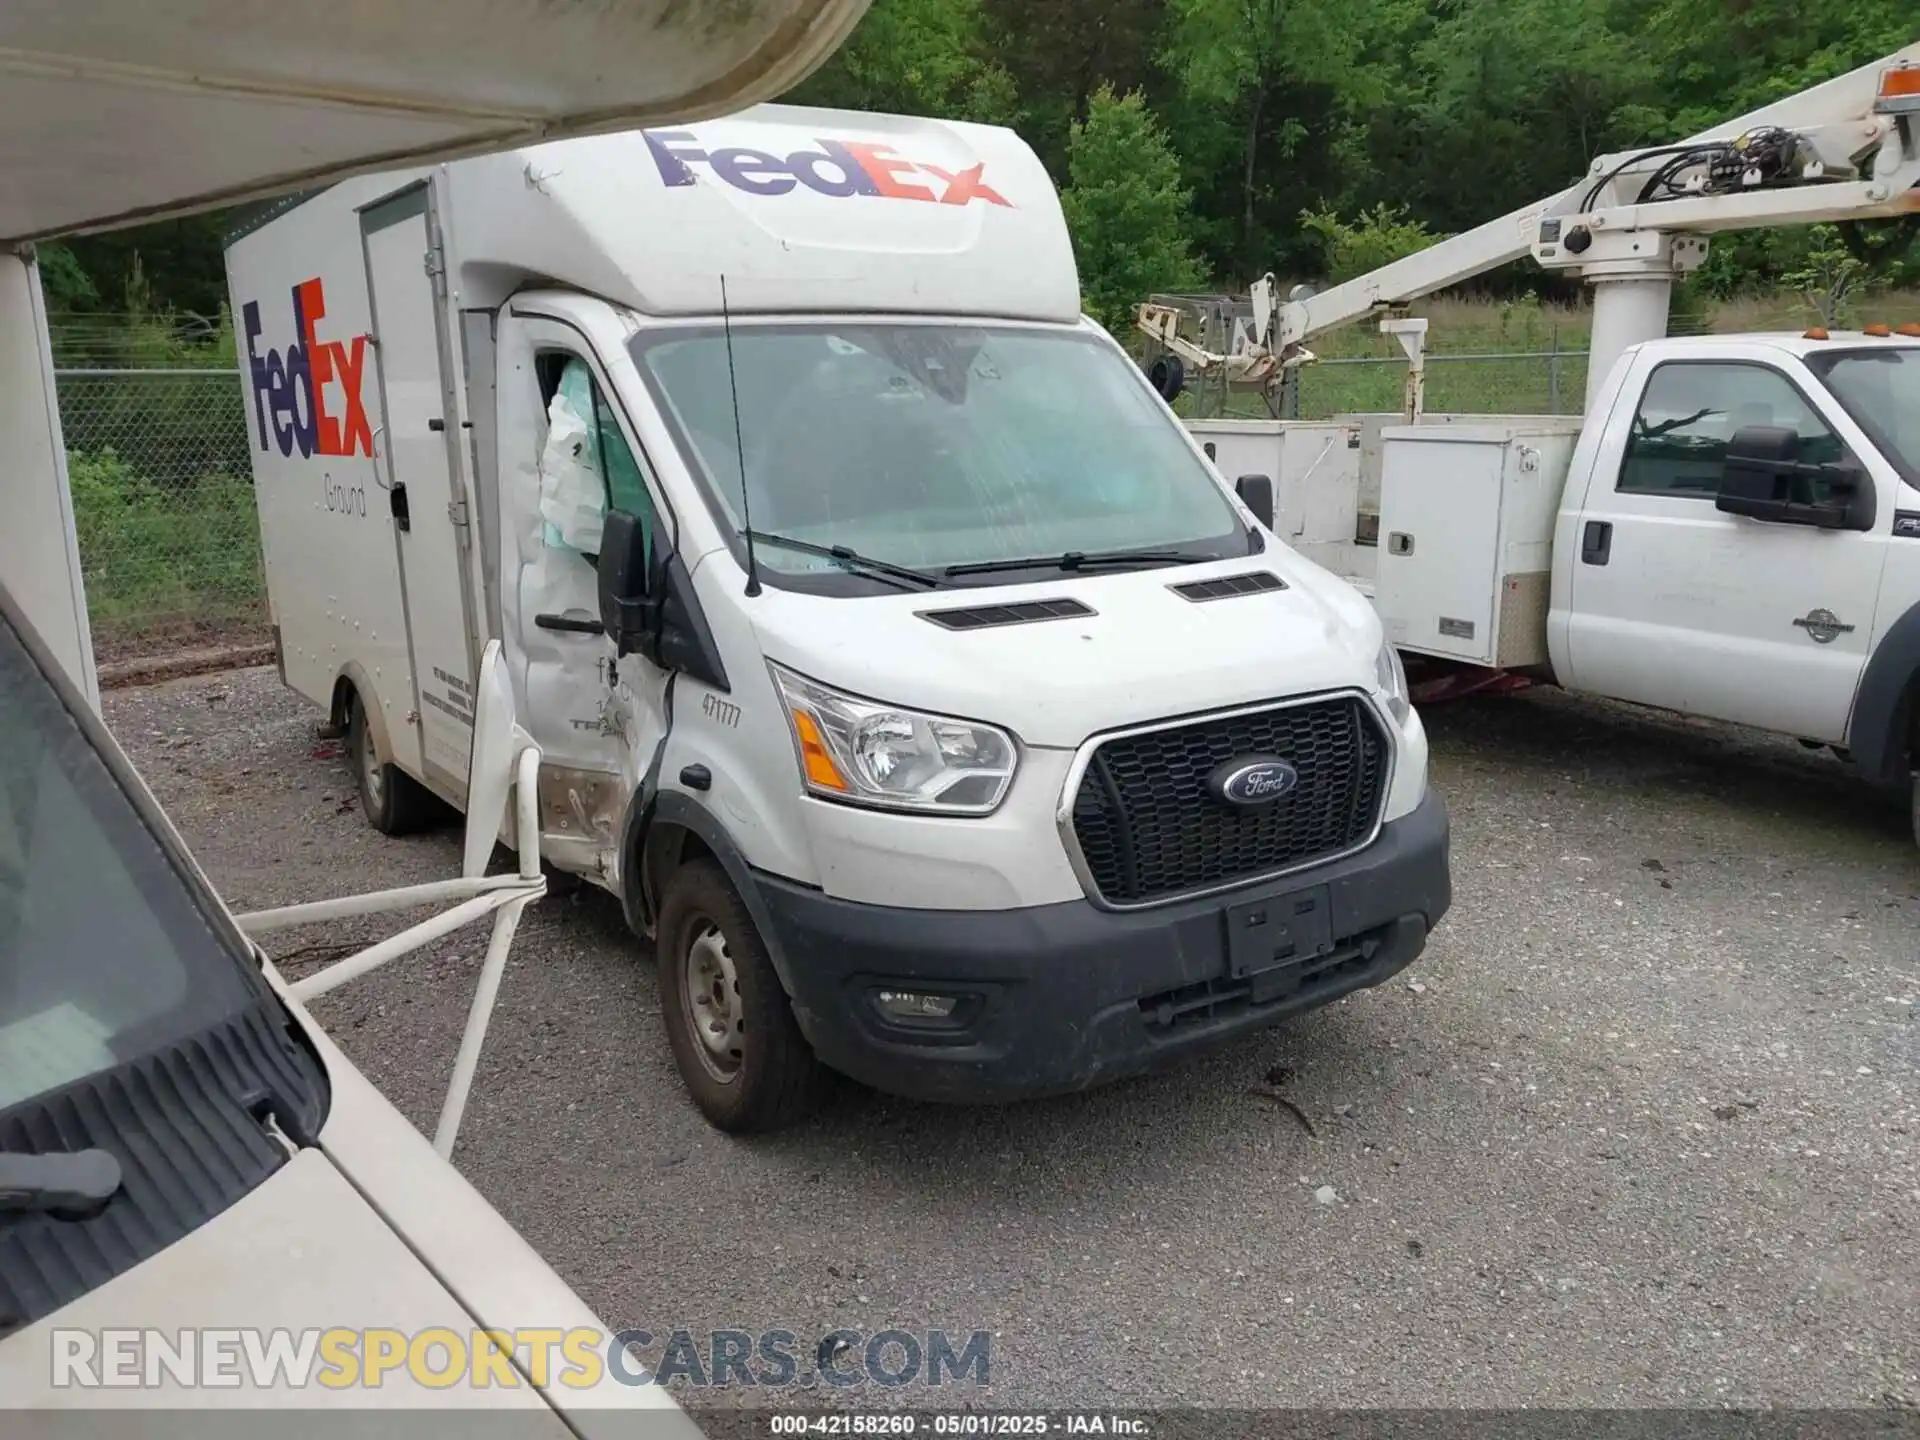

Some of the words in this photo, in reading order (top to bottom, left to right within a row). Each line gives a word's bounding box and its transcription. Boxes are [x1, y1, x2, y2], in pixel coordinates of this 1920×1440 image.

[640, 129, 1021, 210] FedEx
[242, 276, 373, 460] FedEx
[324, 472, 367, 519] Ground
[702, 692, 742, 729] 471777
[1245, 769, 1285, 796] Ford
